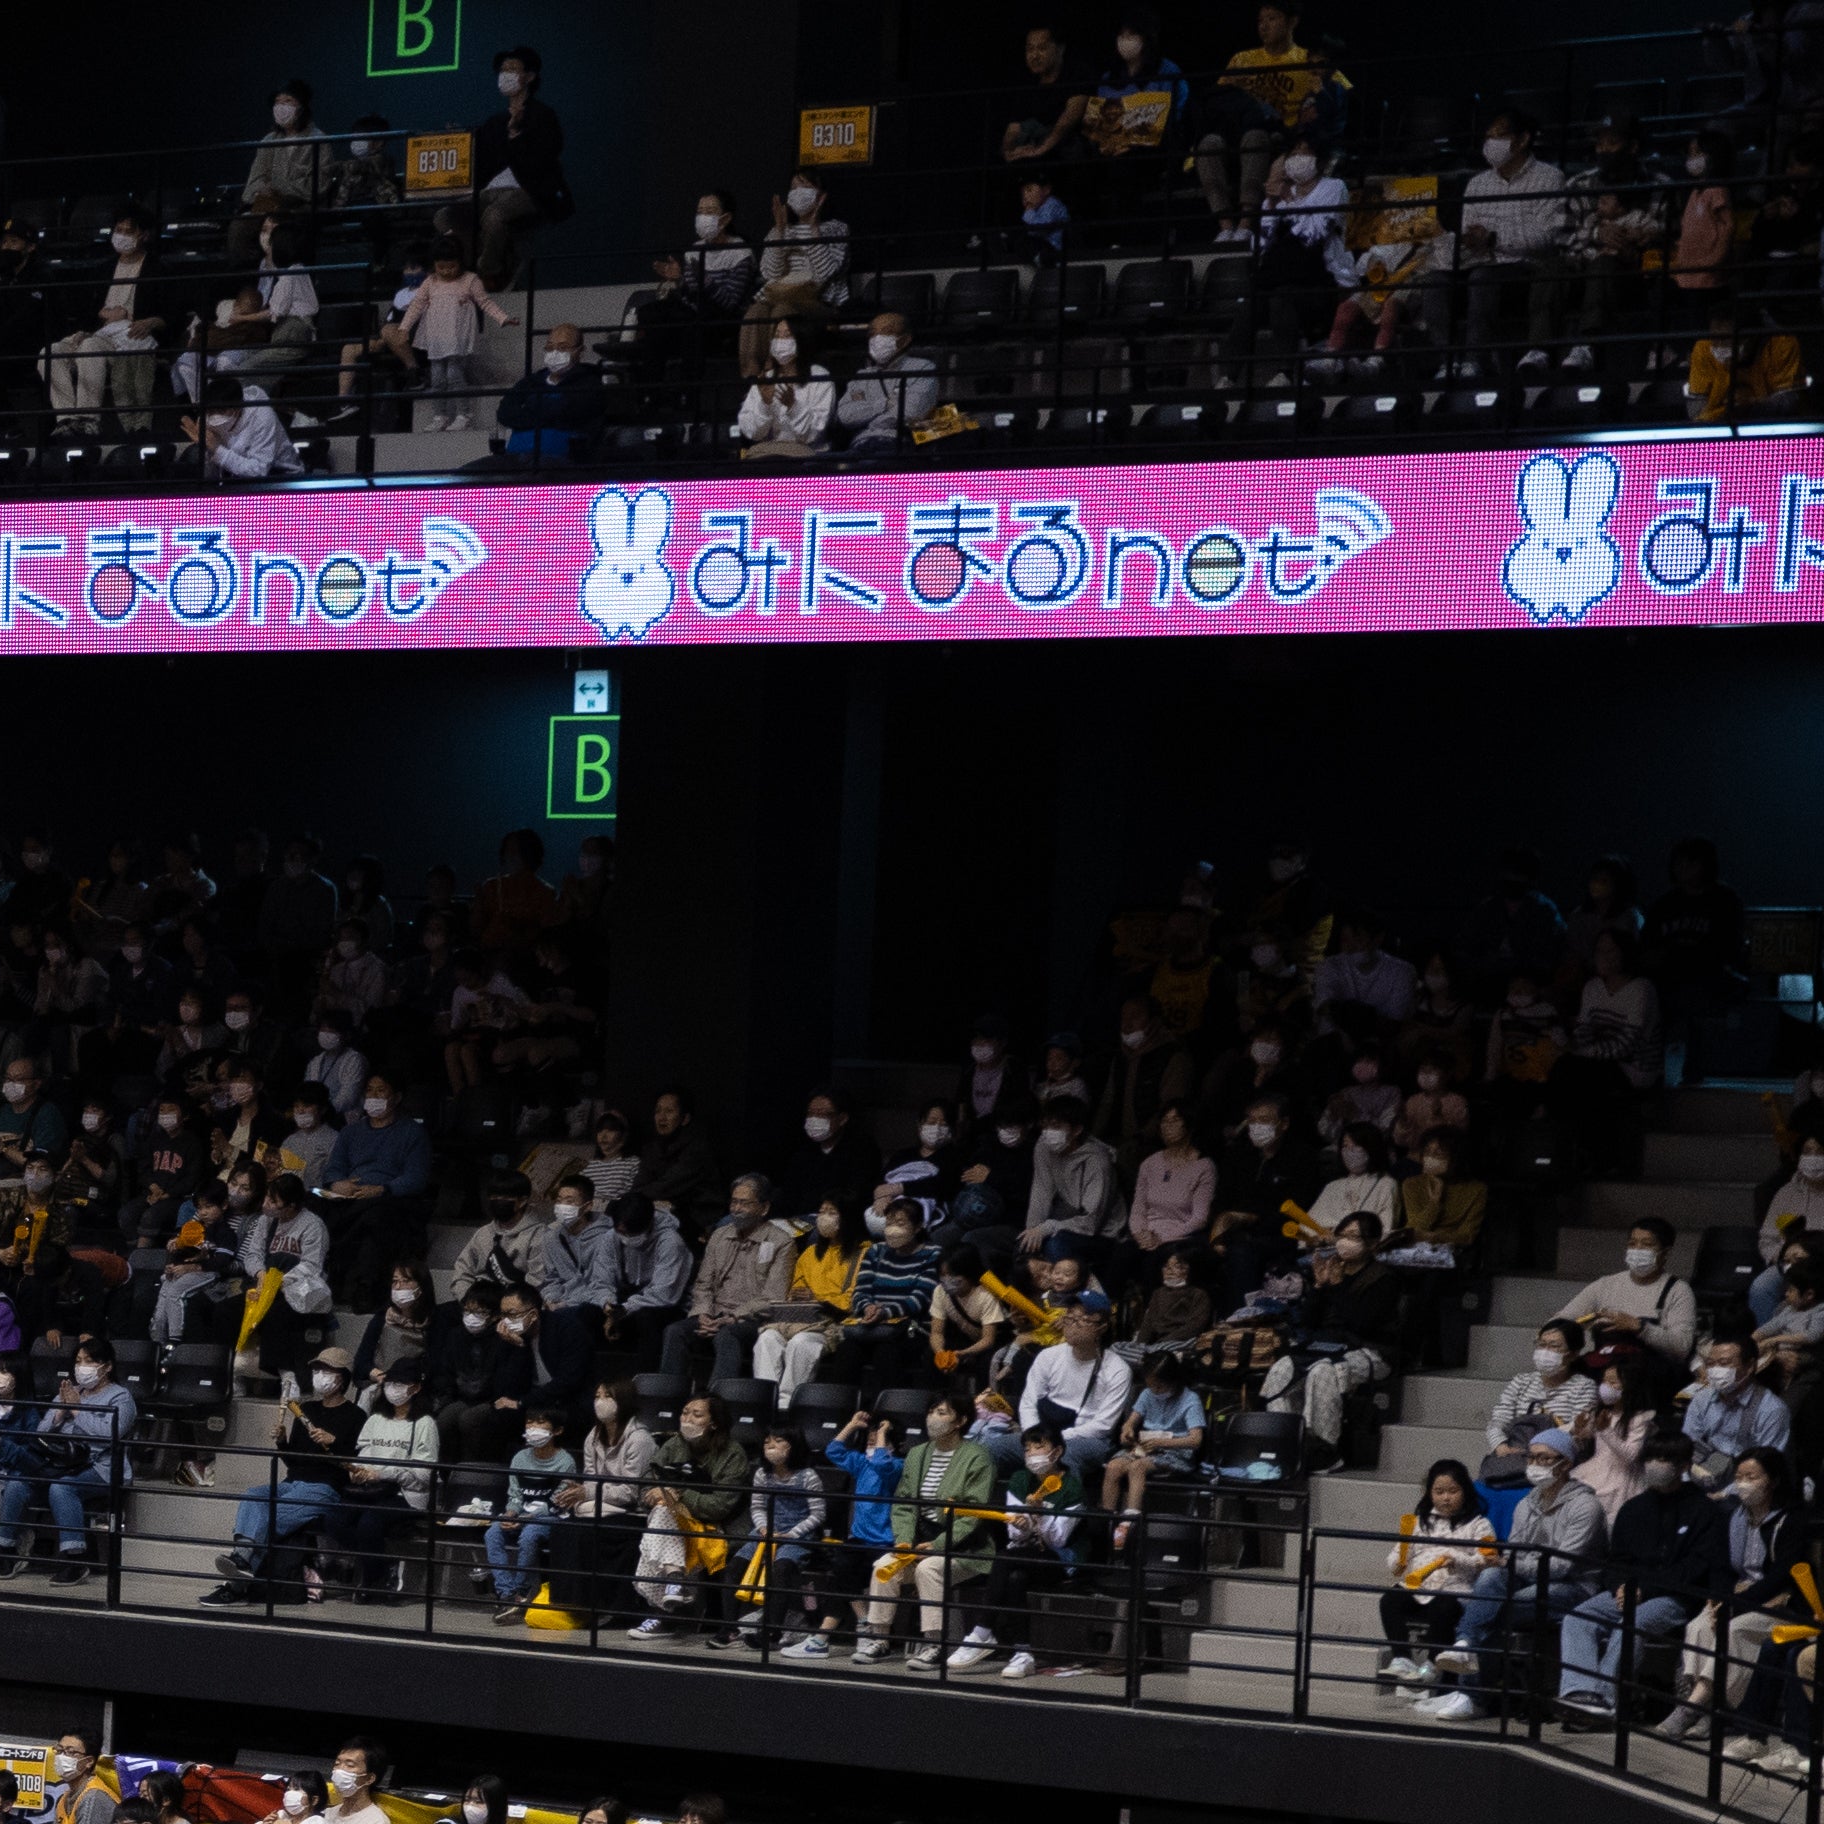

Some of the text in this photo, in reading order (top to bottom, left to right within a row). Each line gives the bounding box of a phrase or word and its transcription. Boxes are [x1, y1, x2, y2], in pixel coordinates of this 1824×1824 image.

[397, 0, 434, 57] B
[688, 496, 1333, 614] みにまるnet
[575, 733, 612, 803] B
